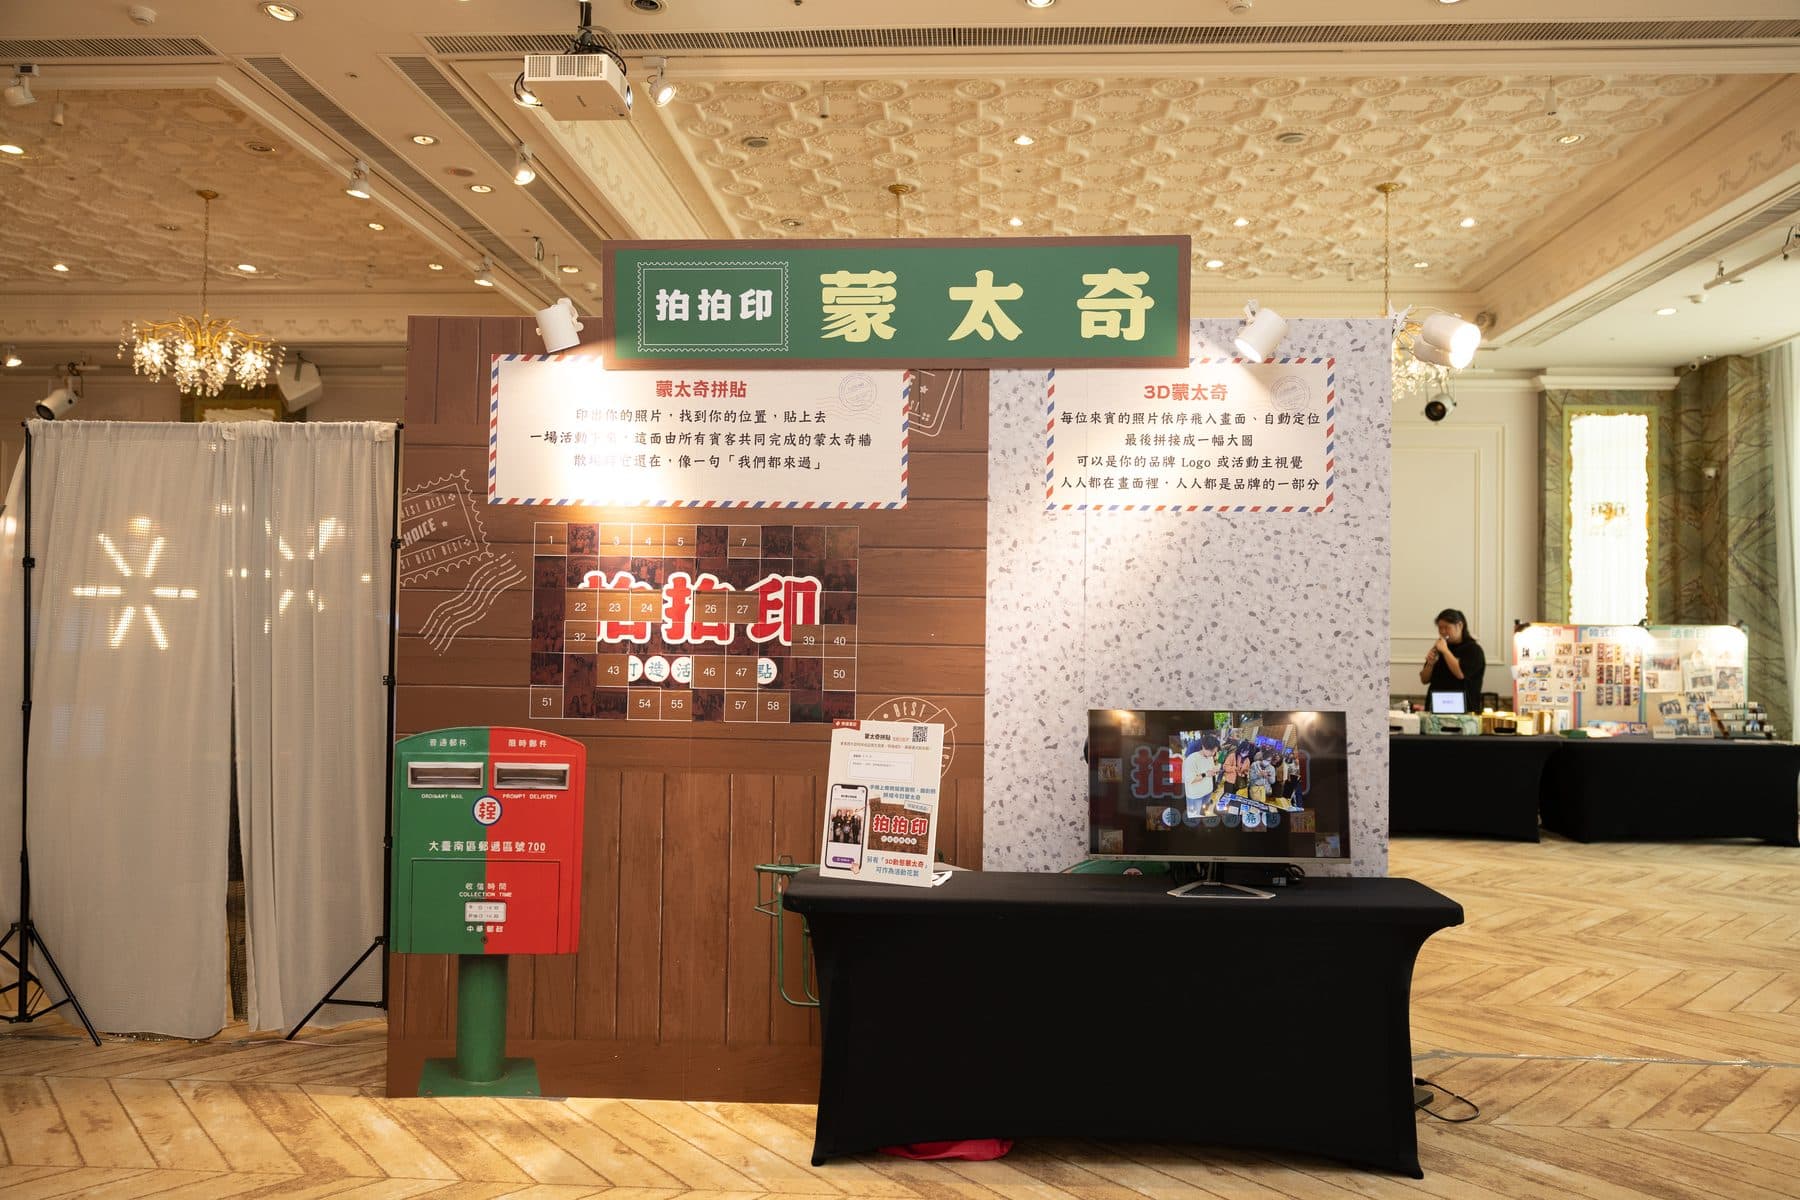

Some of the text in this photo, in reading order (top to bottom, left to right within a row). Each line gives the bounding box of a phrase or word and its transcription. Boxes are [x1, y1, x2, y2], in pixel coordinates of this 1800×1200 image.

[655, 288, 774, 322] 拍拍印
[820, 268, 1155, 343] 蒙太奇
[655, 380, 747, 398] 蒙太奇拼貼
[1143, 383, 1229, 401] 3D蒙太奇
[1060, 411, 1321, 426] 每位來賓的照片依序飛入畫面、自動定位
[1125, 433, 1253, 448] 最後拼接成一幅大圖
[1076, 455, 1303, 470] 可以是你的品牌 Logo 或活動主視覺
[575, 603, 748, 614] 22 23 24 26 27
[574, 632, 846, 646] 32 39 40
[607, 665, 620, 675] 43
[703, 667, 845, 679] 46 47 50
[542, 697, 779, 711] 51 54 55 57 58
[873, 814, 928, 836] 拍拍印
